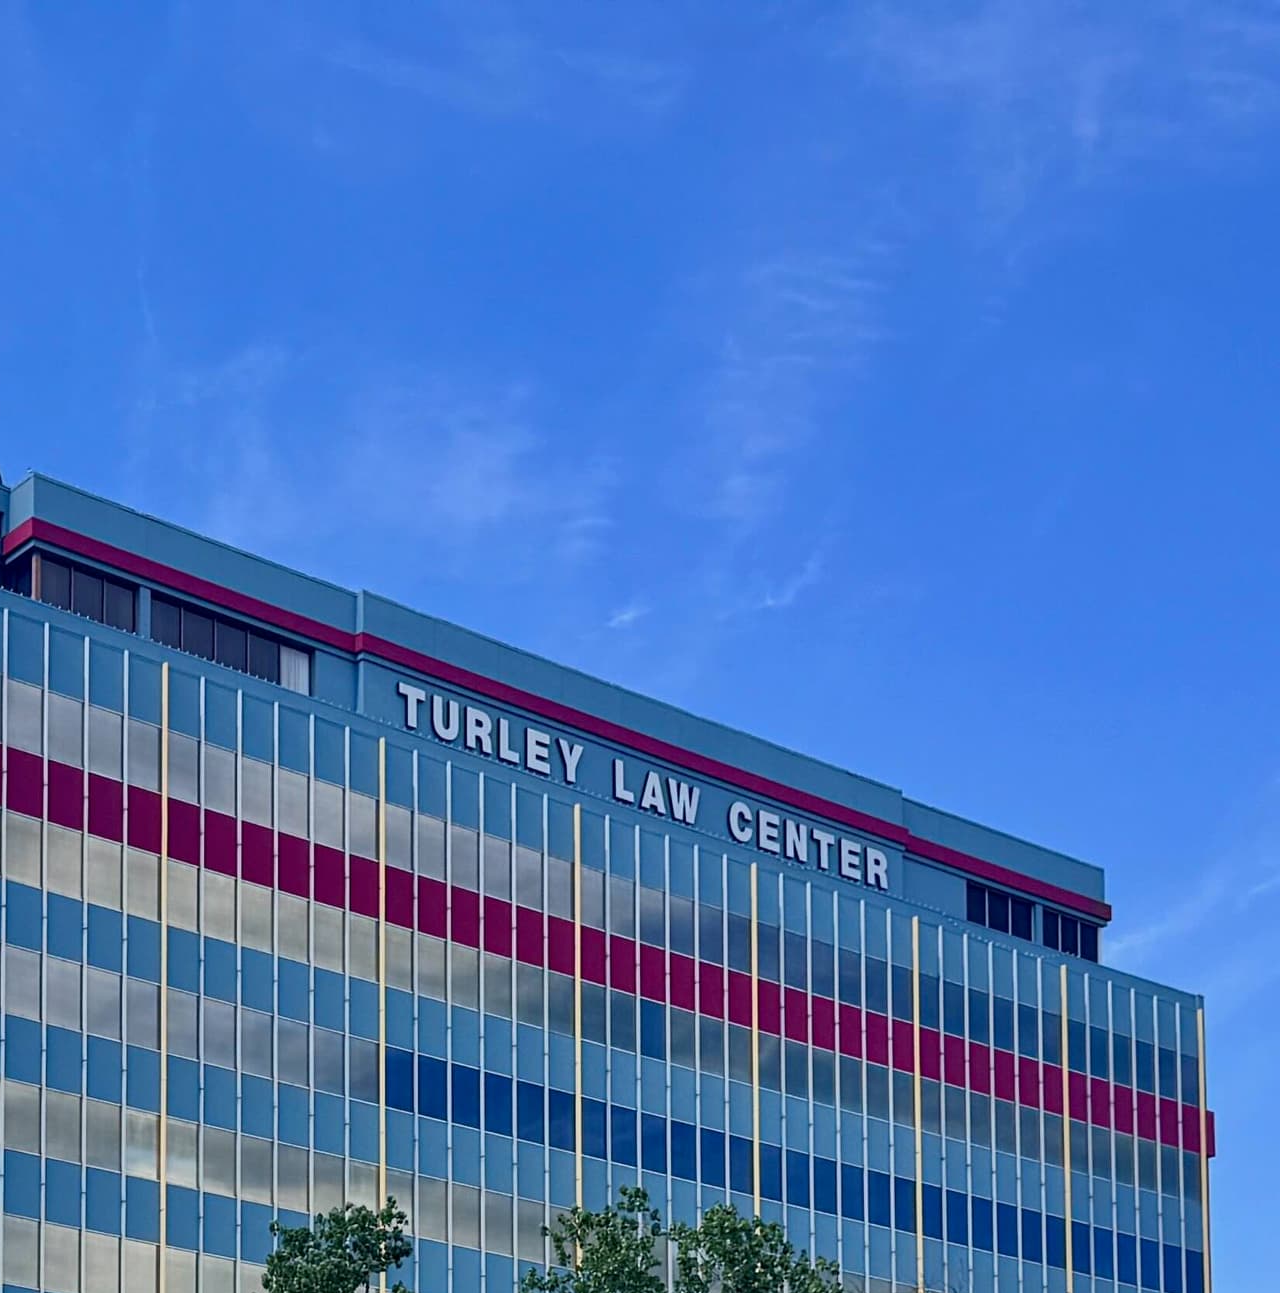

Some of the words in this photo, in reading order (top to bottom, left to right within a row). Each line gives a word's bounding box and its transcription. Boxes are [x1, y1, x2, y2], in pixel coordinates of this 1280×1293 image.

[397, 681, 585, 784] TURLEY
[612, 757, 701, 826] LAW
[728, 800, 890, 891] CENTER
